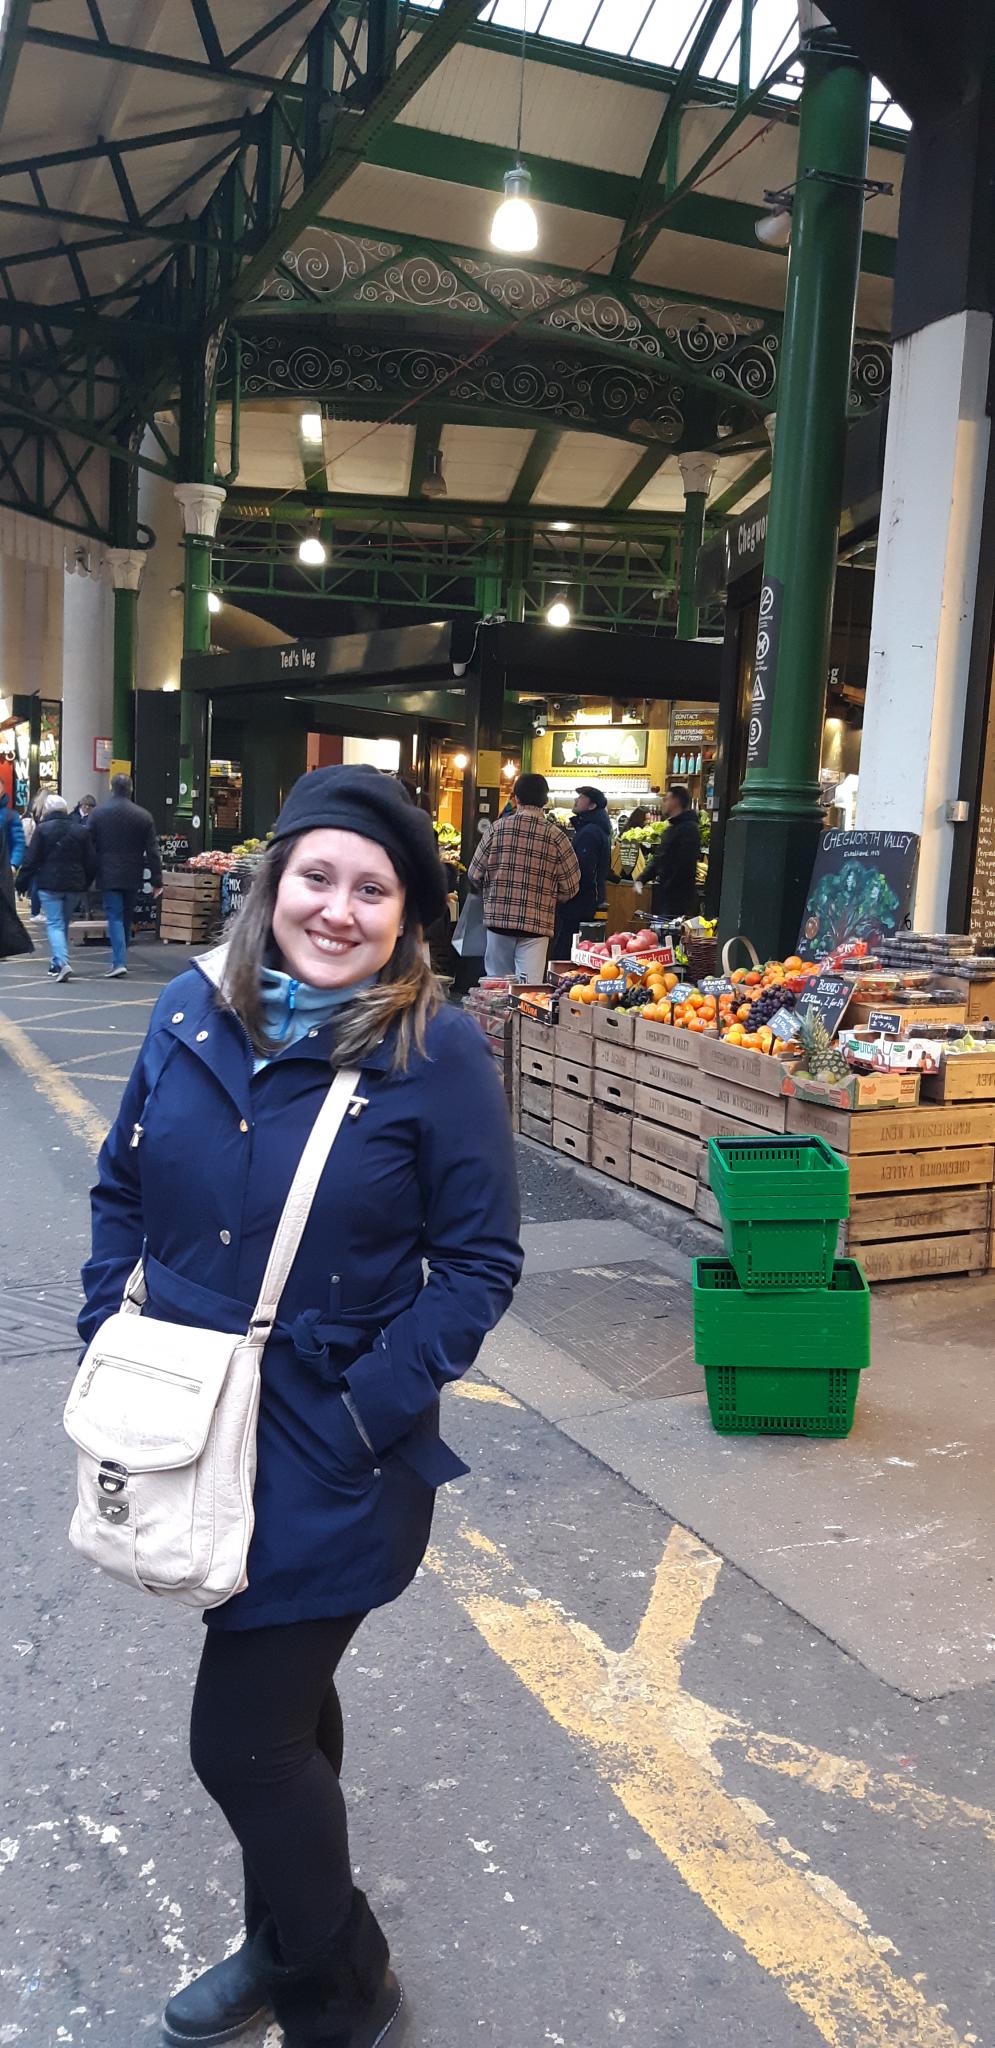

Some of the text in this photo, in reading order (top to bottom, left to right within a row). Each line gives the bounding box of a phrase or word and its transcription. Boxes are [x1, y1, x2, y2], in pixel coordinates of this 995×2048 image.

[280, 648, 316, 668] Ted's Veg
[823, 831, 913, 854] CHEGWORTH VALLEY
[229, 878, 241, 892] MIX
[817, 979, 842, 993] BERRIES
[823, 997, 829, 1008] 2
[828, 999, 836, 1009] for
[715, 1088, 730, 1104] KENT
[880, 1126, 905, 1141] KENT
[880, 1161, 971, 1180] CHEGWORTH VALLEY
